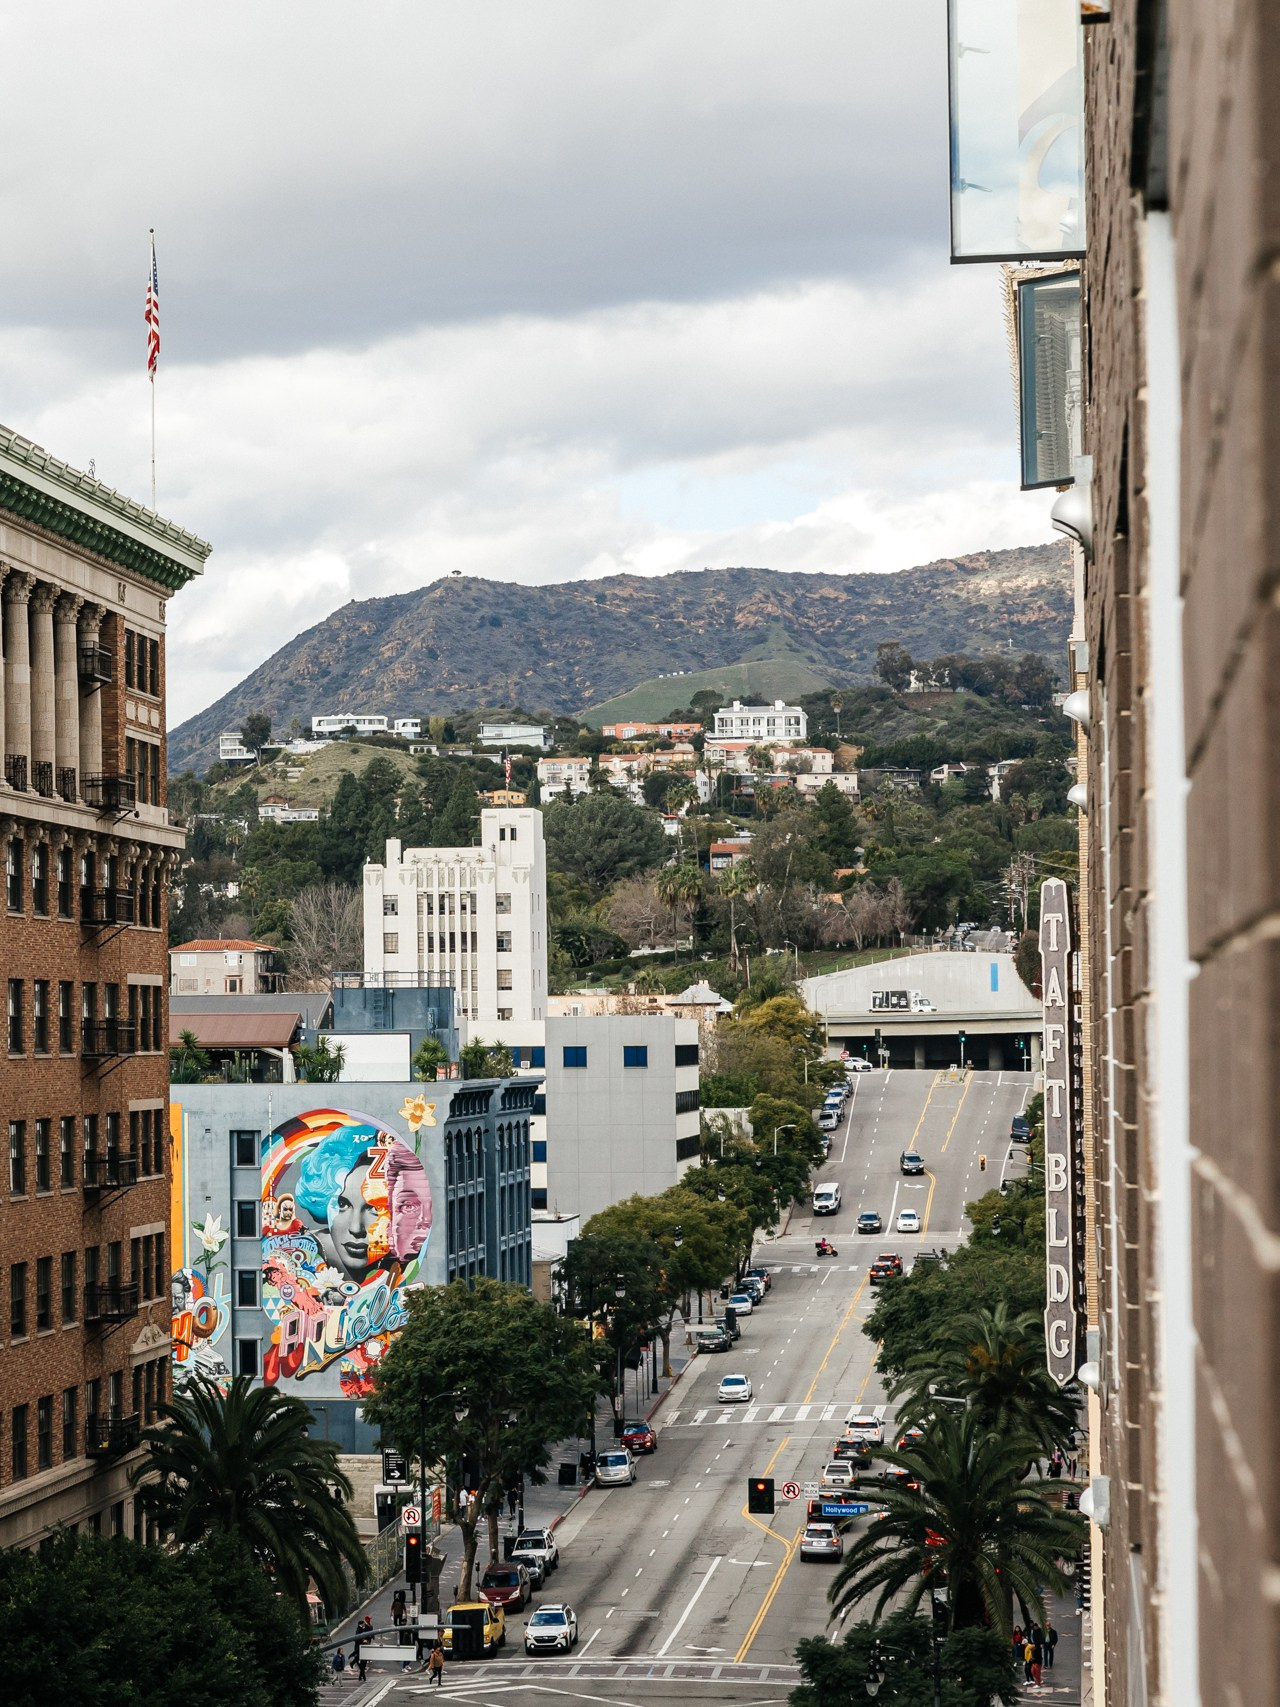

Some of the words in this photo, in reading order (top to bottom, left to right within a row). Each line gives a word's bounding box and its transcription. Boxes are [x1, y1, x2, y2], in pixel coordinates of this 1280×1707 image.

[1043, 912, 1066, 1119] TAFT
[1047, 1153, 1070, 1360] BLDG
[825, 1506, 858, 1515] Hollywood
